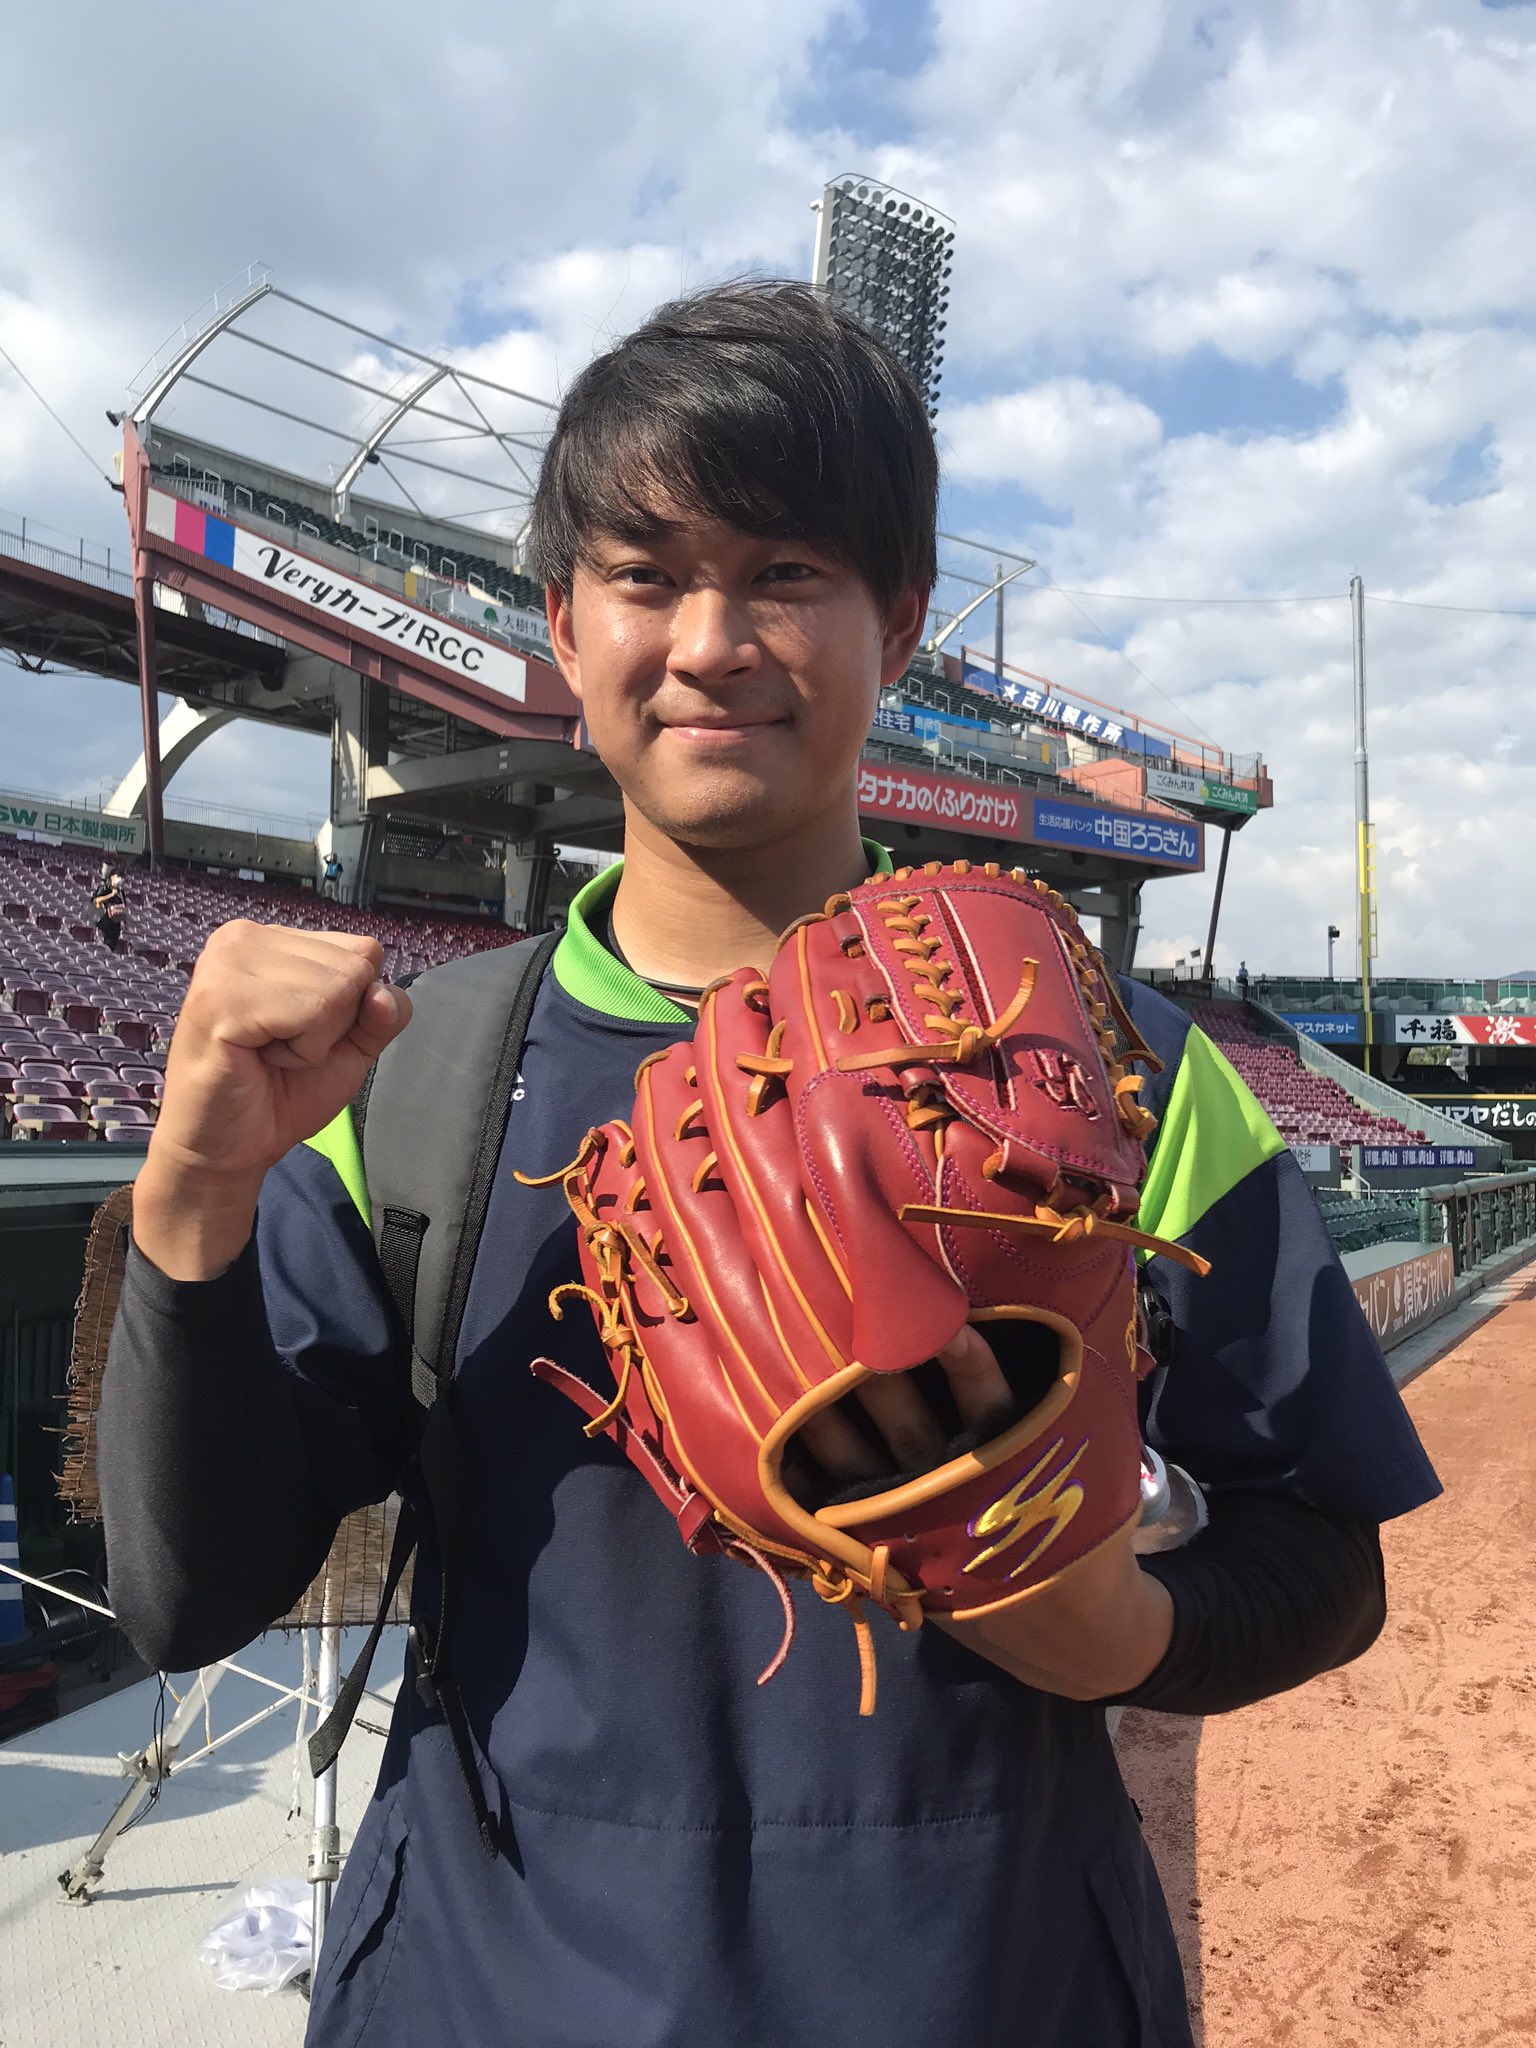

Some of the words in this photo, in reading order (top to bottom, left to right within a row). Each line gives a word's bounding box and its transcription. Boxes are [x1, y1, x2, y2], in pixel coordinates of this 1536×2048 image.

[414, 624, 485, 672] RCC
[873, 711, 910, 732] 住宅
[1021, 690, 1123, 744] 古川製作所
[1094, 815, 1195, 859] 中国ろうきん
[1294, 1021, 1356, 1035] アスカネット
[1484, 1015, 1536, 1045] 激
